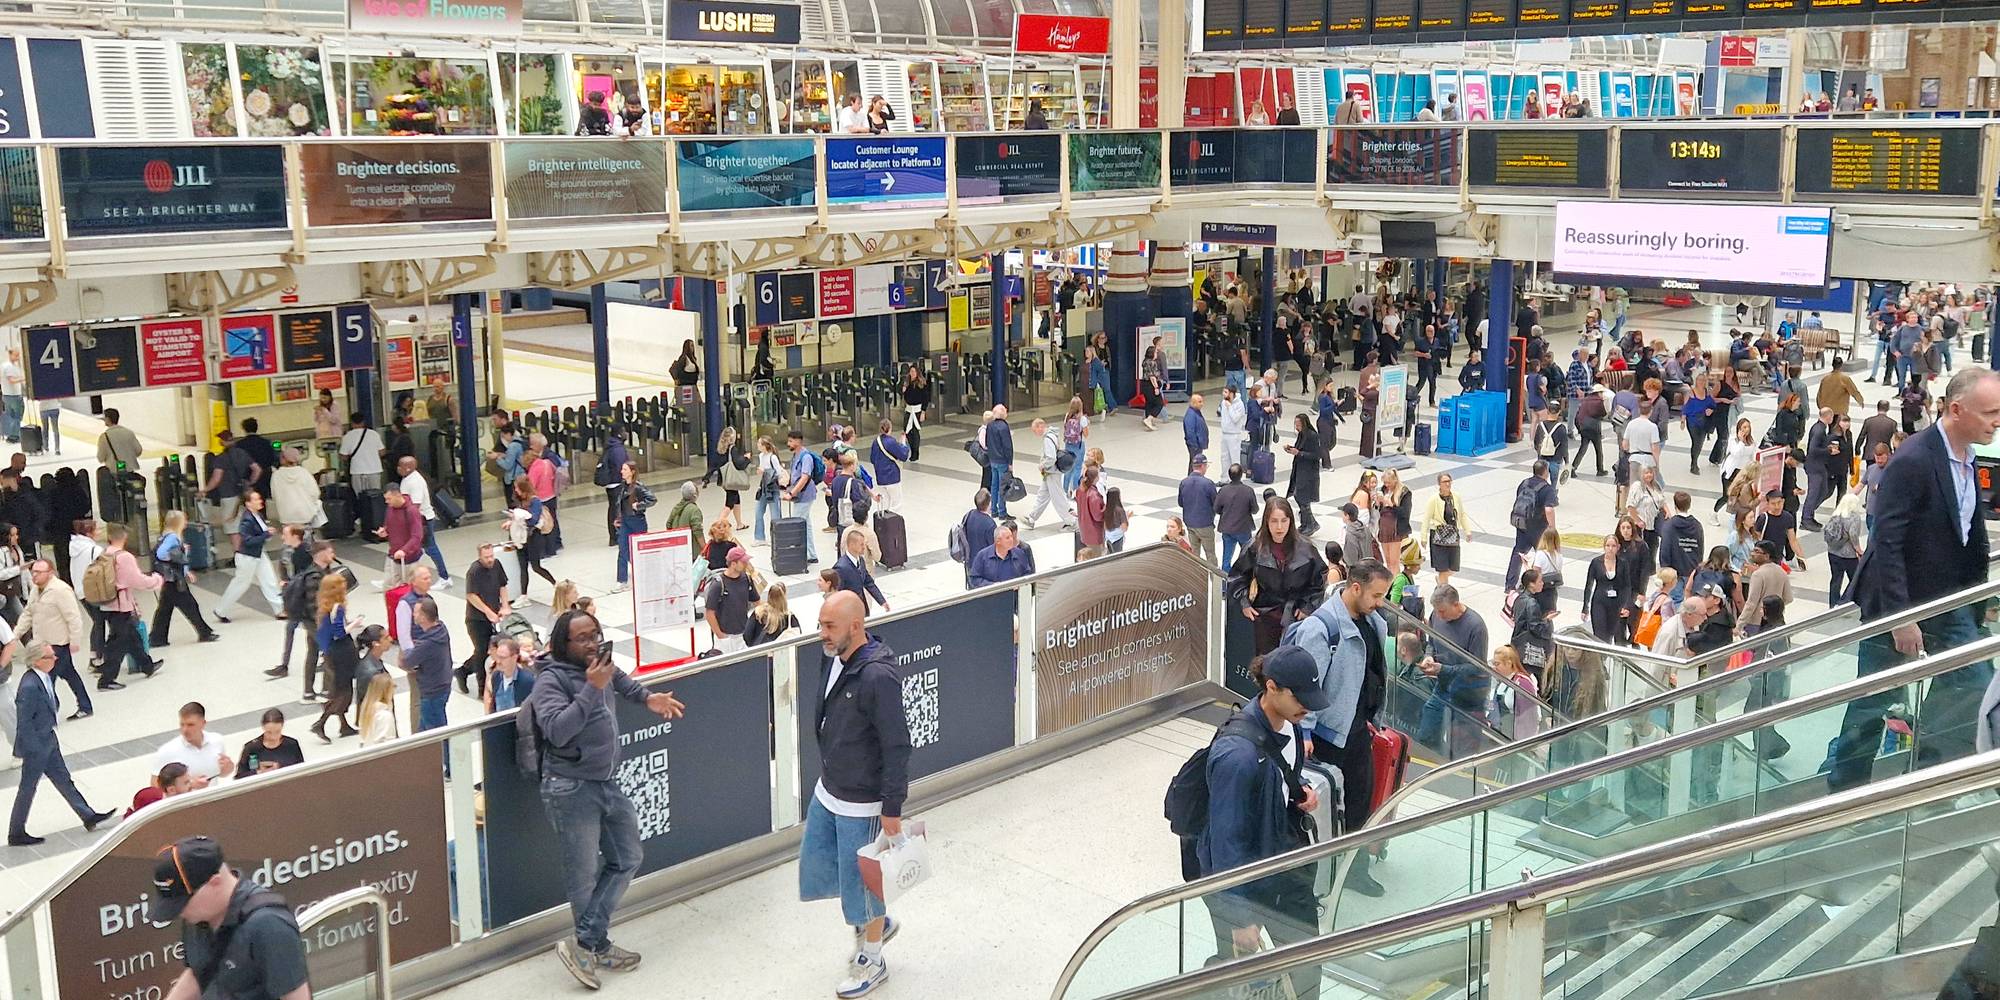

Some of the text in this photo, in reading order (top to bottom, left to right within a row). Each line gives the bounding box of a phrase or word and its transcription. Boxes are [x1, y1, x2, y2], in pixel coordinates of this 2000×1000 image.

[430, 0, 506, 20] Flowers
[698, 10, 751, 32] LUSH
[752, 14, 776, 22] FRESH
[1046, 21, 1080, 50] Hamleys
[856, 145, 918, 156] Customer Lounge
[1008, 145, 1020, 155] JLL
[1089, 145, 1143, 158] Brighter futures.
[1201, 143, 1215, 156] JLL
[1362, 141, 1423, 153] Brighter cities.
[336, 160, 460, 179] Brighter decisions.
[528, 158, 644, 174] Brighter intelligence.
[705, 155, 790, 170] Brighter together.
[831, 157, 942, 170] located adjacent to Platform 10
[173, 165, 212, 186] JLL
[703, 173, 794, 185] Tap into local expertise backed
[345, 183, 455, 195] Turn real estate complexity
[545, 178, 630, 188] See around corners with
[725, 185, 744, 195] global
[760, 184, 781, 194] insight.
[351, 196, 368, 206] into
[376, 196, 396, 206] clear
[418, 195, 452, 205] forward.
[553, 189, 624, 201] AI-powered insights.
[103, 203, 256, 218] SEE A BRIGHTER WAY
[1222, 224, 1246, 233] Platforms
[1252, 226, 1258, 234] to
[1565, 228, 1750, 254] Reassuringly boring.
[931, 268, 941, 288] 7
[1661, 280, 1700, 290] JCDecaux
[760, 281, 774, 304] 6
[1008, 279, 1015, 292] 7
[893, 288, 900, 301] 6
[824, 304, 848, 312] departure
[152, 329, 182, 337] OYSTER
[346, 315, 364, 343] 5
[455, 322, 462, 339] 5
[146, 337, 162, 345] NOT
[152, 343, 195, 351] STANSTED
[40, 339, 64, 369] 4
[157, 350, 192, 359] AIRPORT
[1046, 592, 1197, 649] Brighter intelligence.
[913, 644, 942, 662] more
[1058, 623, 1187, 676] See around corners with
[1069, 652, 1176, 696] AI-powered insights.
[1235, 665, 1251, 680] SEE
[634, 722, 672, 743] more
[250, 828, 408, 890] decisions.
[94, 951, 154, 983] Turn
